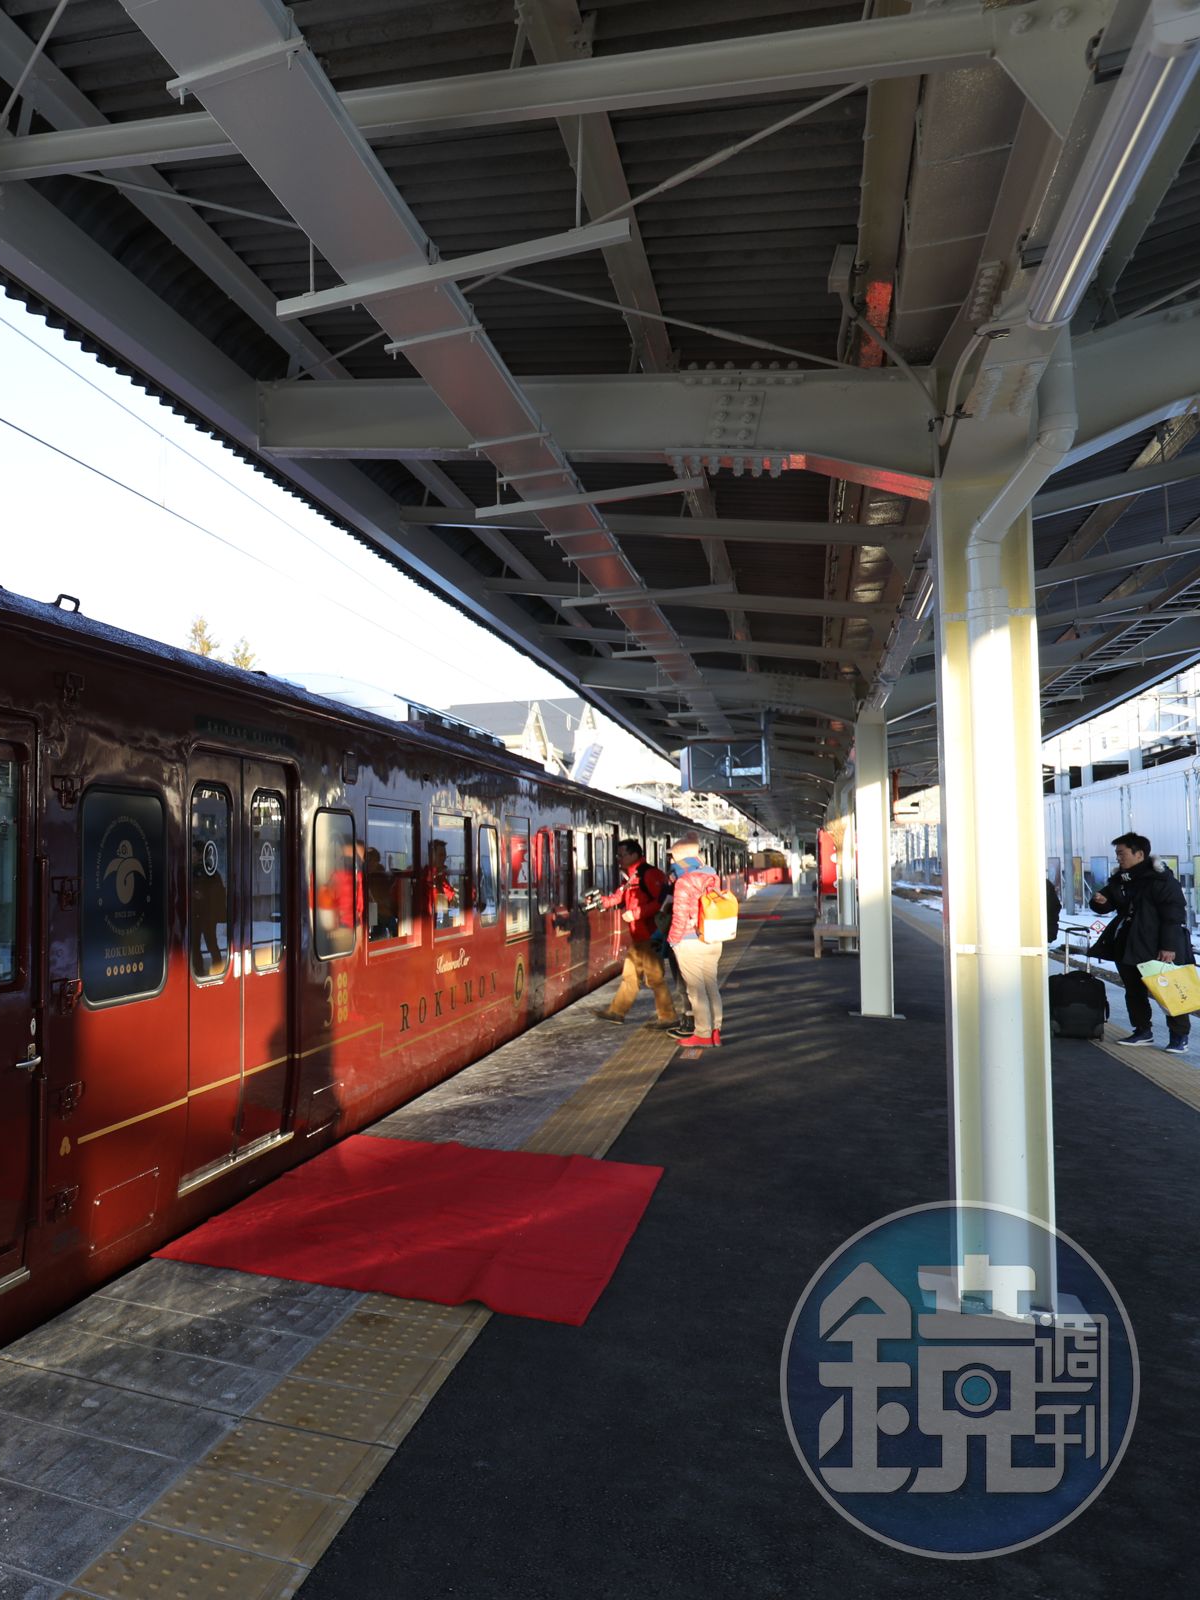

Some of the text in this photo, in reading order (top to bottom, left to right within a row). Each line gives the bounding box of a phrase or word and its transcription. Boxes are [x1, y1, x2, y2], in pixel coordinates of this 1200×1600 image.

[105, 943, 145, 960] ROKUMON
[323, 975, 334, 1028] 3
[399, 971, 497, 1033] ROKUMON
